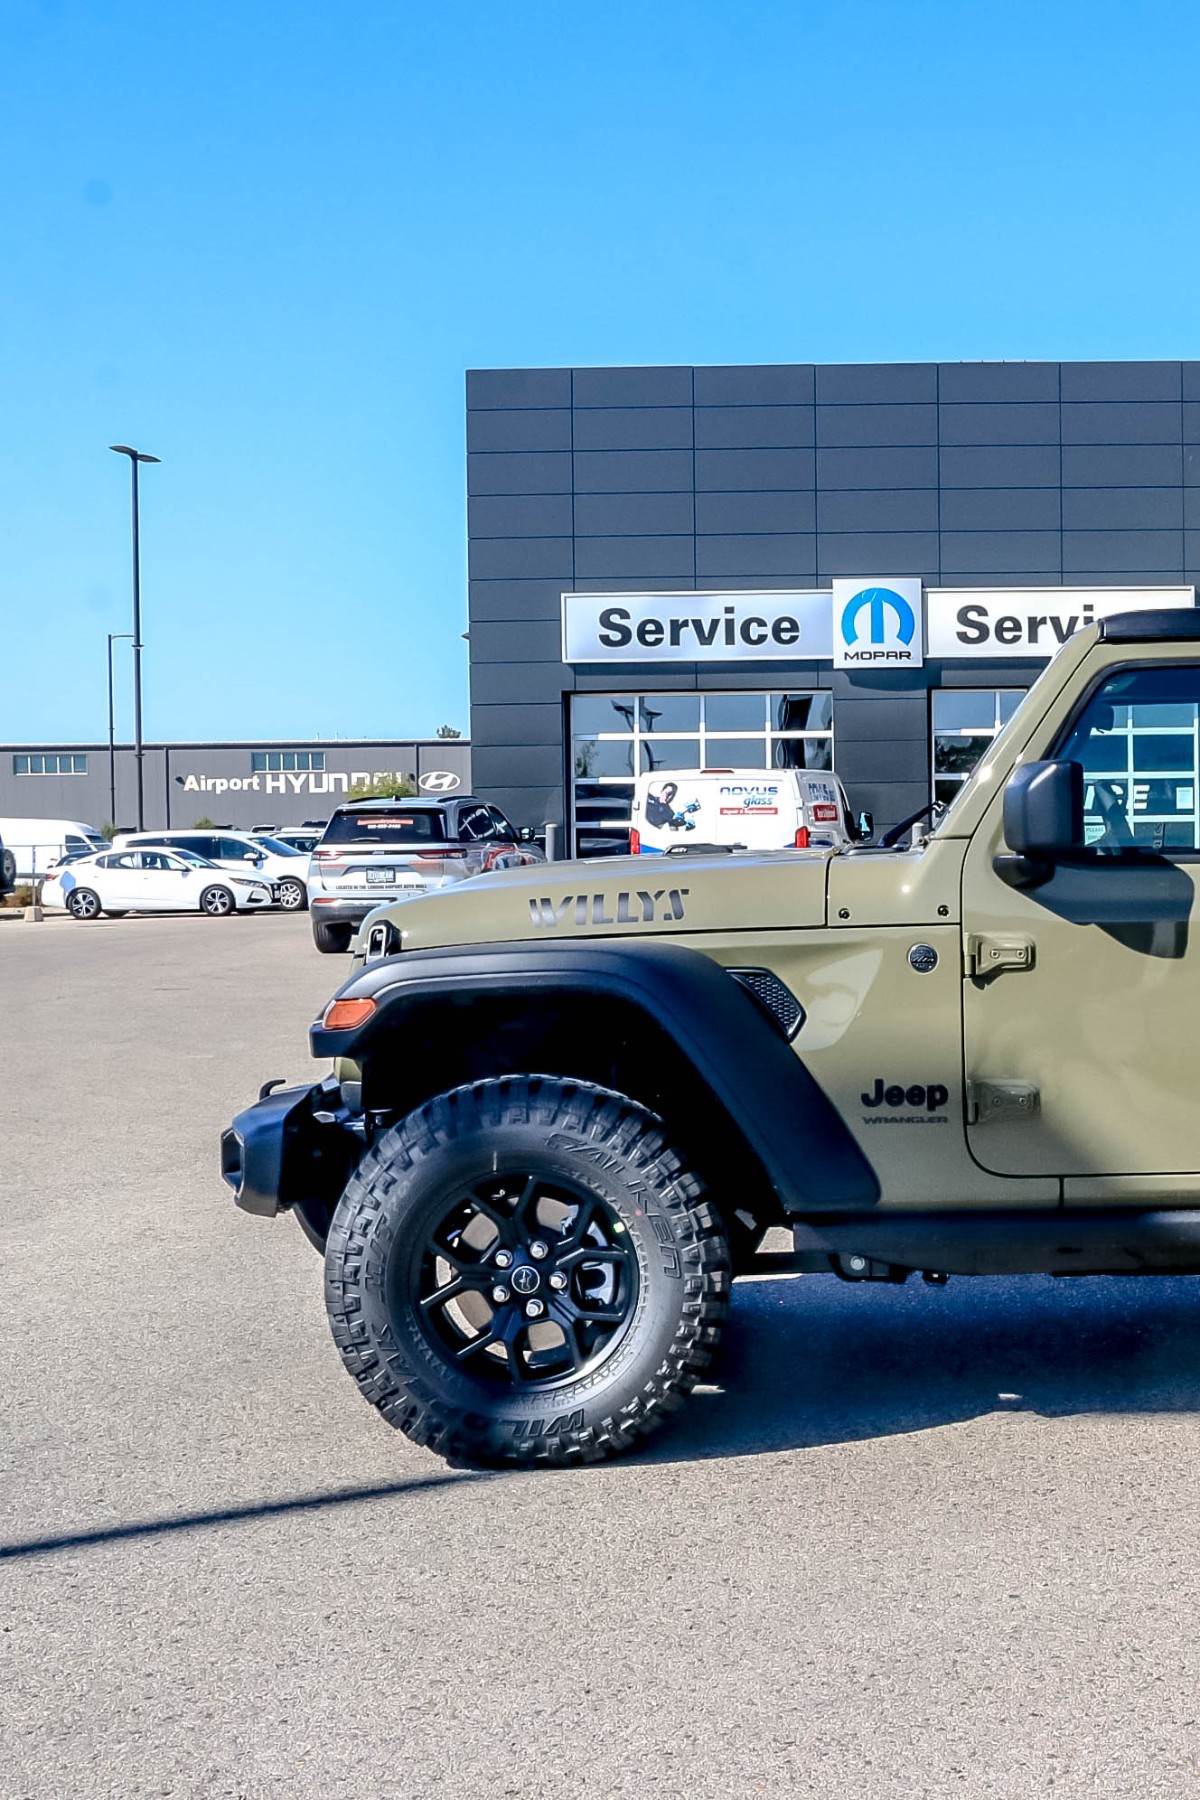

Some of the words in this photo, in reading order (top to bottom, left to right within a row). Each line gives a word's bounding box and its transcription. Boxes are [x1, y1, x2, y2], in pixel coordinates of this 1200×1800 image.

[598, 606, 801, 647] Service
[955, 603, 1095, 645] Servi
[844, 650, 912, 661] MOPAR
[184, 774, 260, 795] Airport
[743, 795, 773, 809] glass
[529, 888, 690, 928] WILLYS
[861, 1078, 949, 1112] Jeep
[862, 1116, 948, 1124] WRANGLER
[544, 1132, 682, 1279] FALKEN
